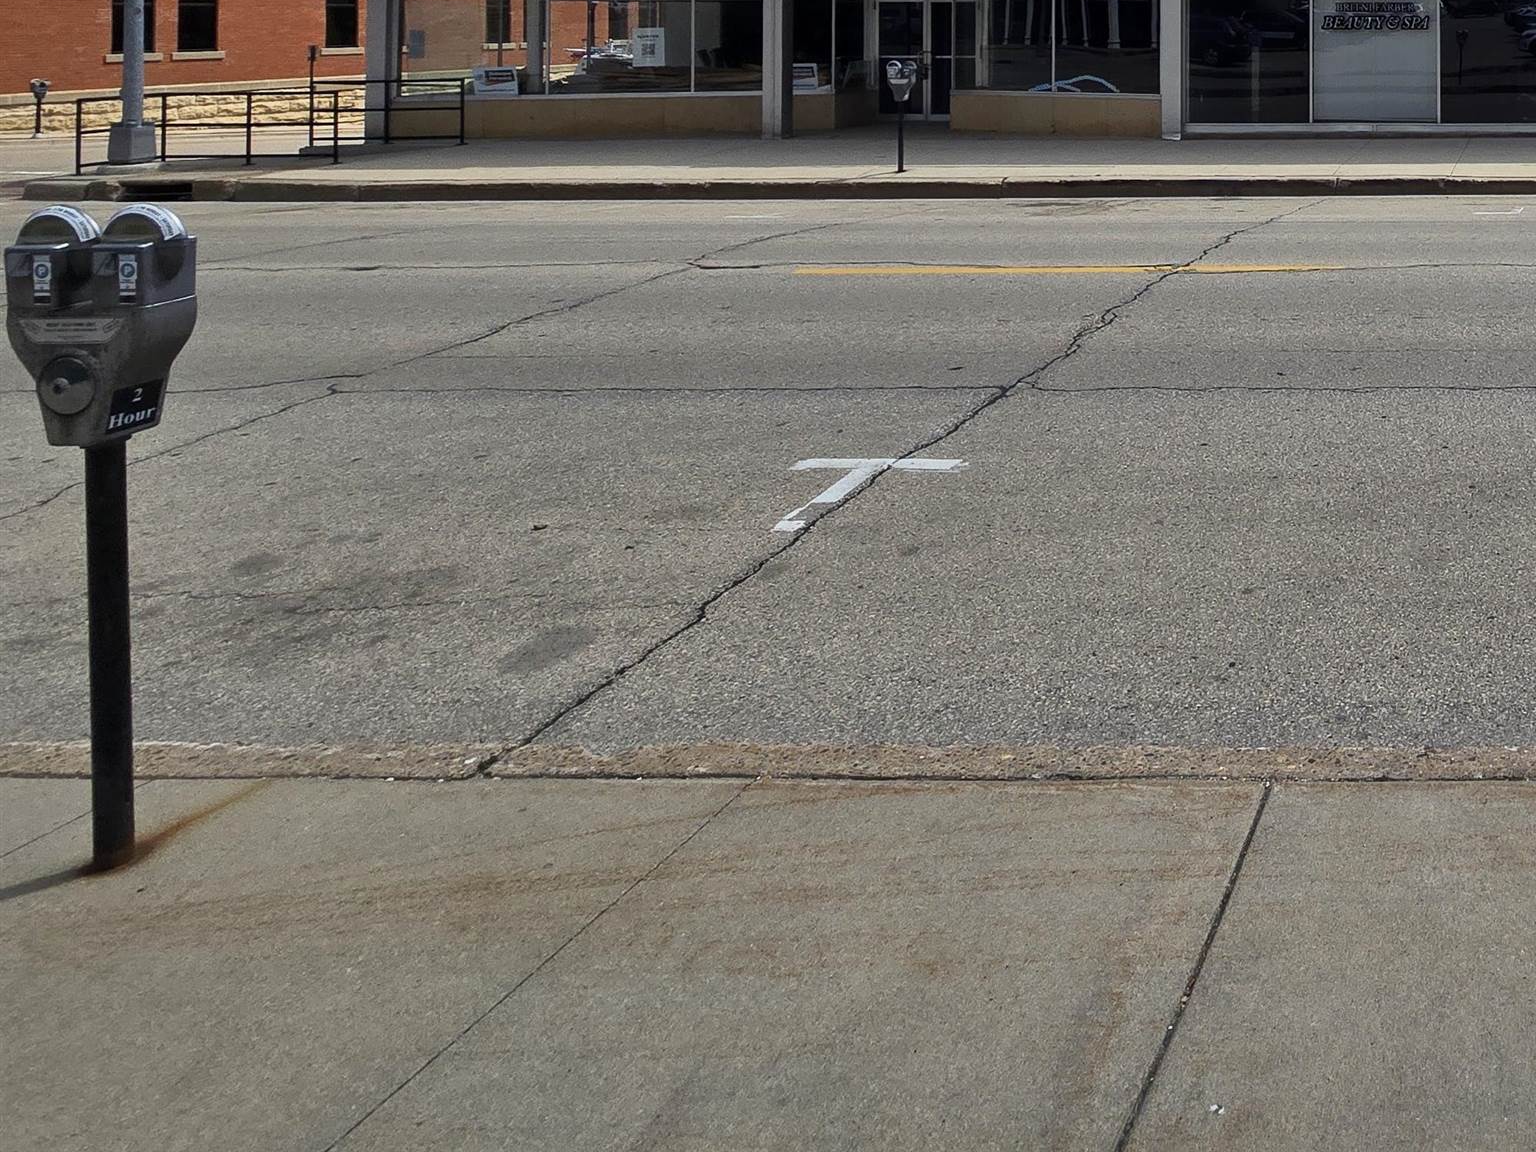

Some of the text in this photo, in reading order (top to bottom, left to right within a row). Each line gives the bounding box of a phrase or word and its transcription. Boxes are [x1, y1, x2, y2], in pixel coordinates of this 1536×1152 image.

[1322, 15, 1430, 30] BEAUTY & SPA
[131, 387, 144, 404] 2
[108, 407, 157, 430] Hour
